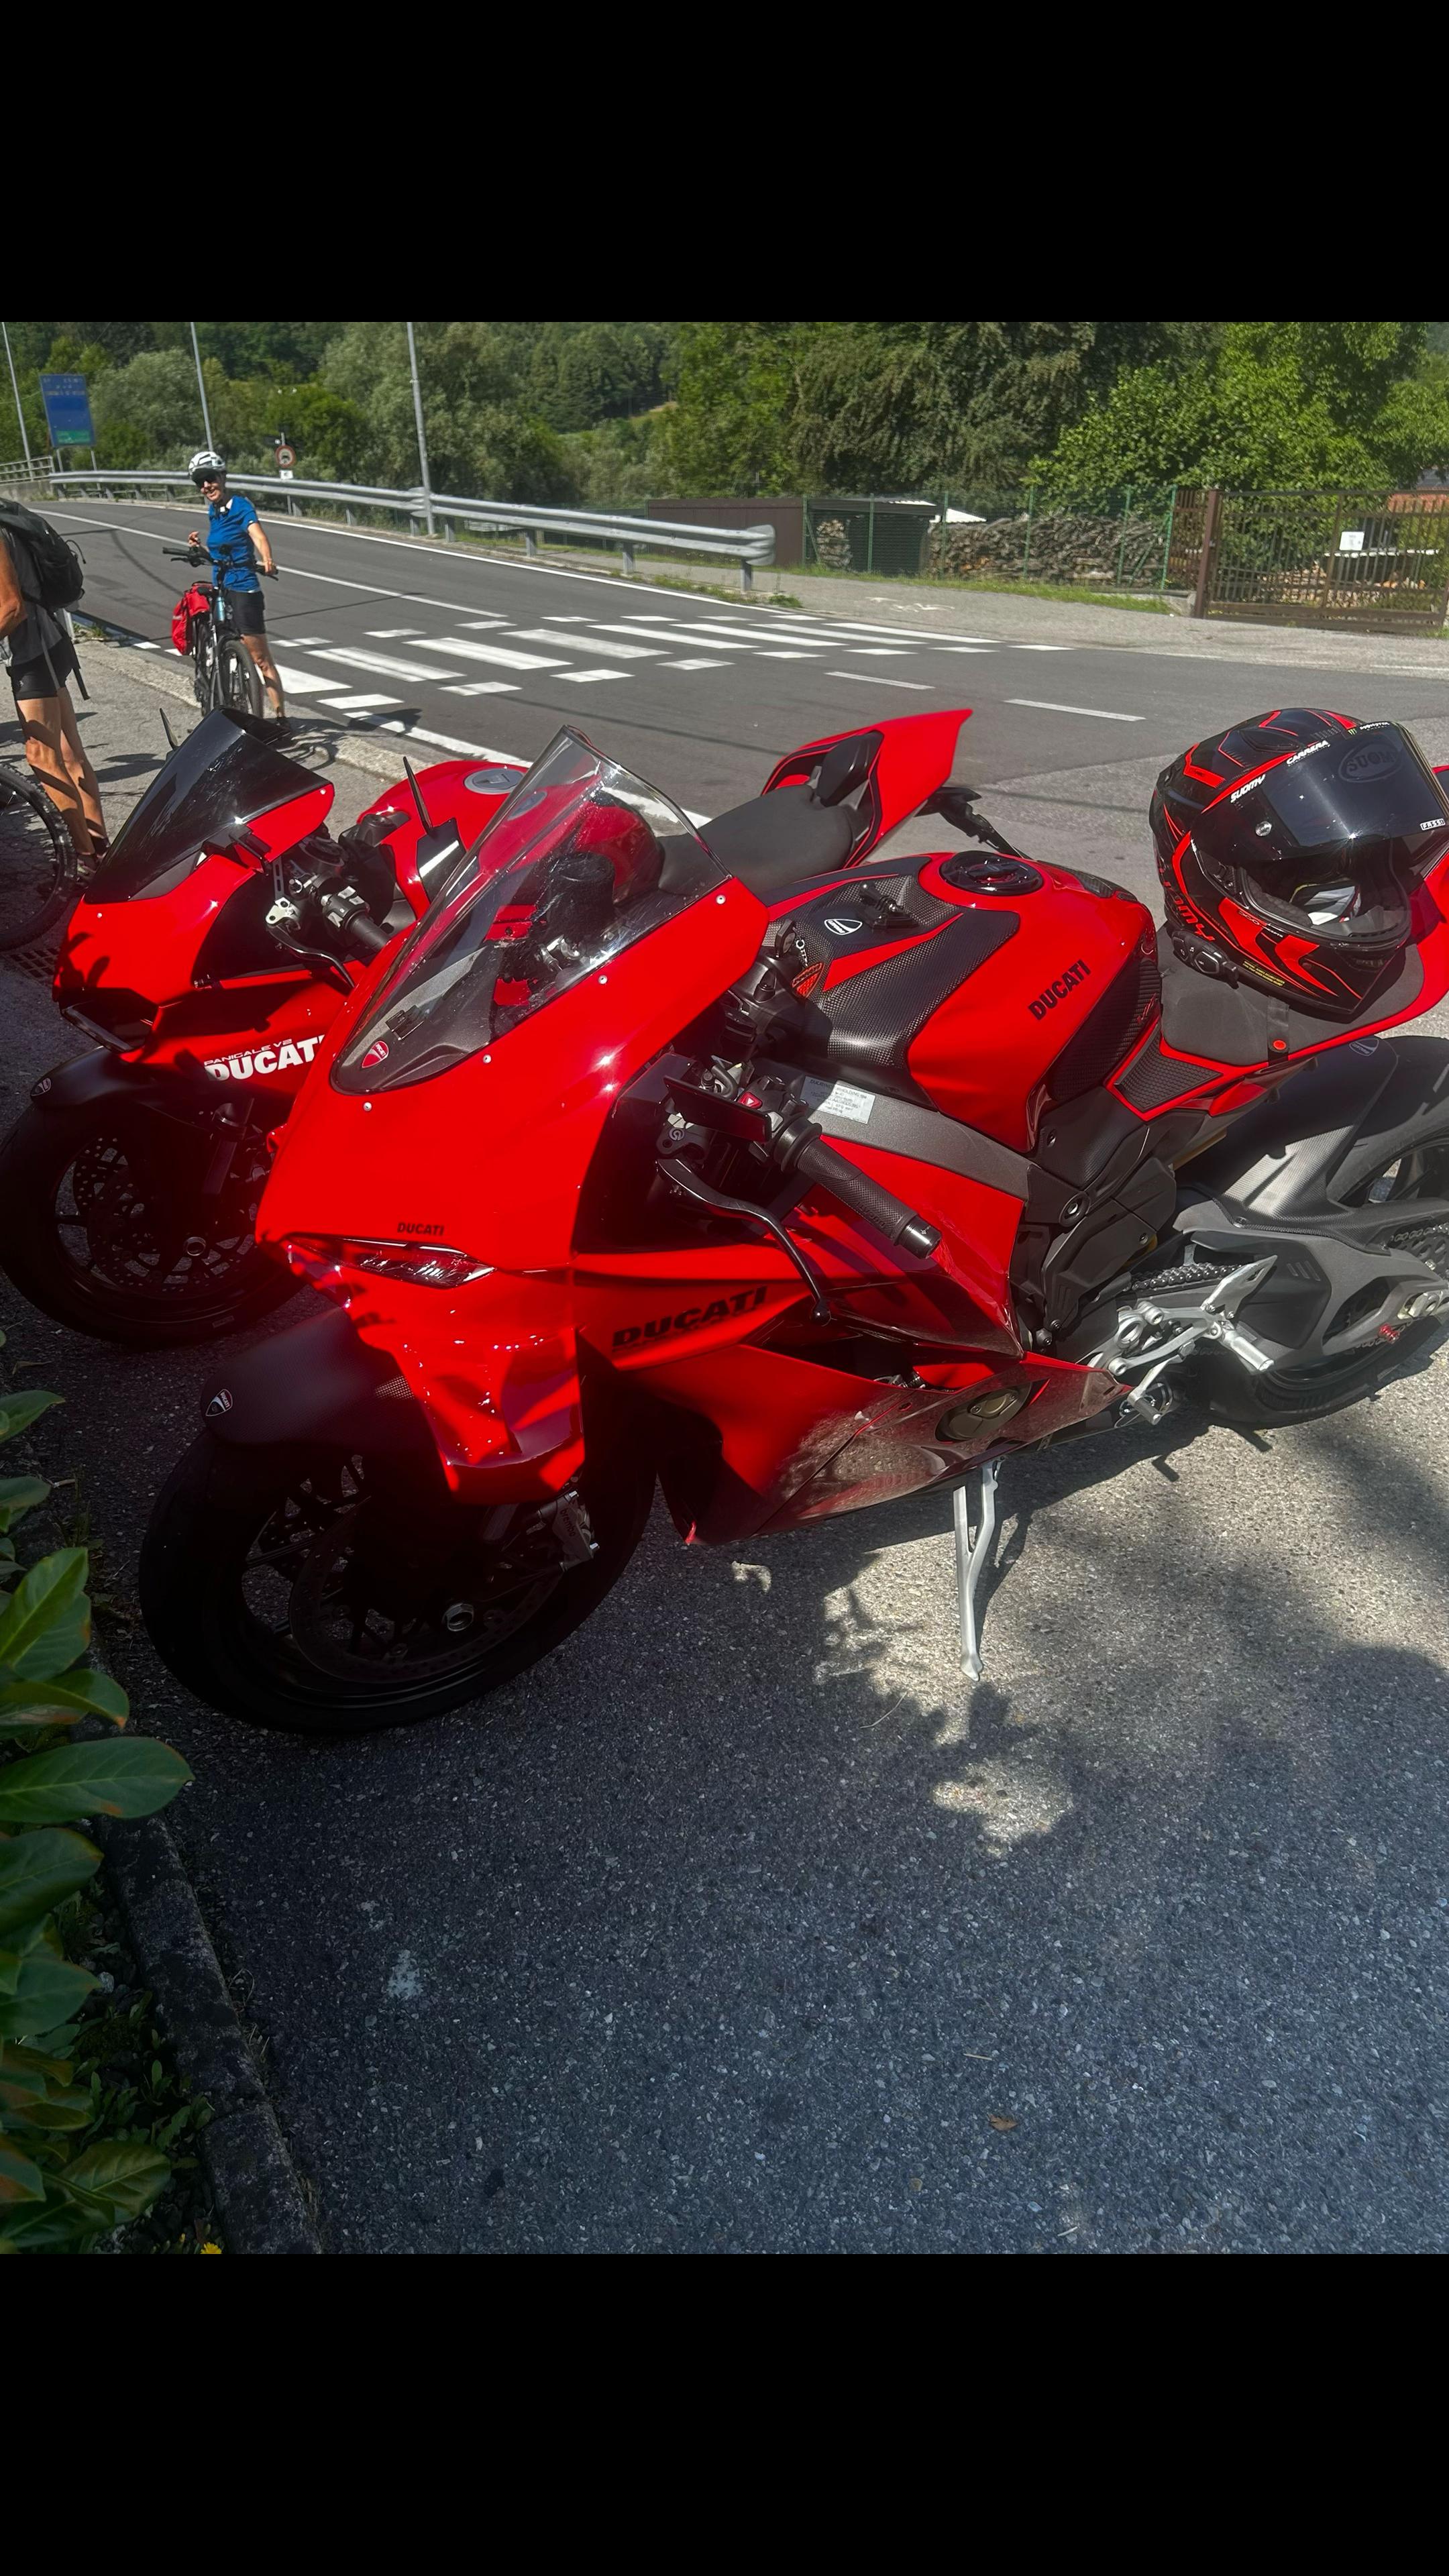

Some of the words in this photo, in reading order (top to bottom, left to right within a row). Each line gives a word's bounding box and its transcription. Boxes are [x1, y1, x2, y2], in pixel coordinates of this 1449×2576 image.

[1287, 740, 1329, 764] CARRERA
[1230, 773, 1266, 803] SUOMY
[1028, 959, 1091, 1020] DUCATI
[204, 1044, 271, 1066] PANIGALE
[273, 1038, 292, 1048] V2
[204, 1034, 325, 1081] DUCAT
[397, 1222, 444, 1236] DUCATI
[612, 1285, 767, 1346] DUCATI
[221, 1391, 230, 1408] DUCATI
[559, 1507, 576, 1537] brembo
